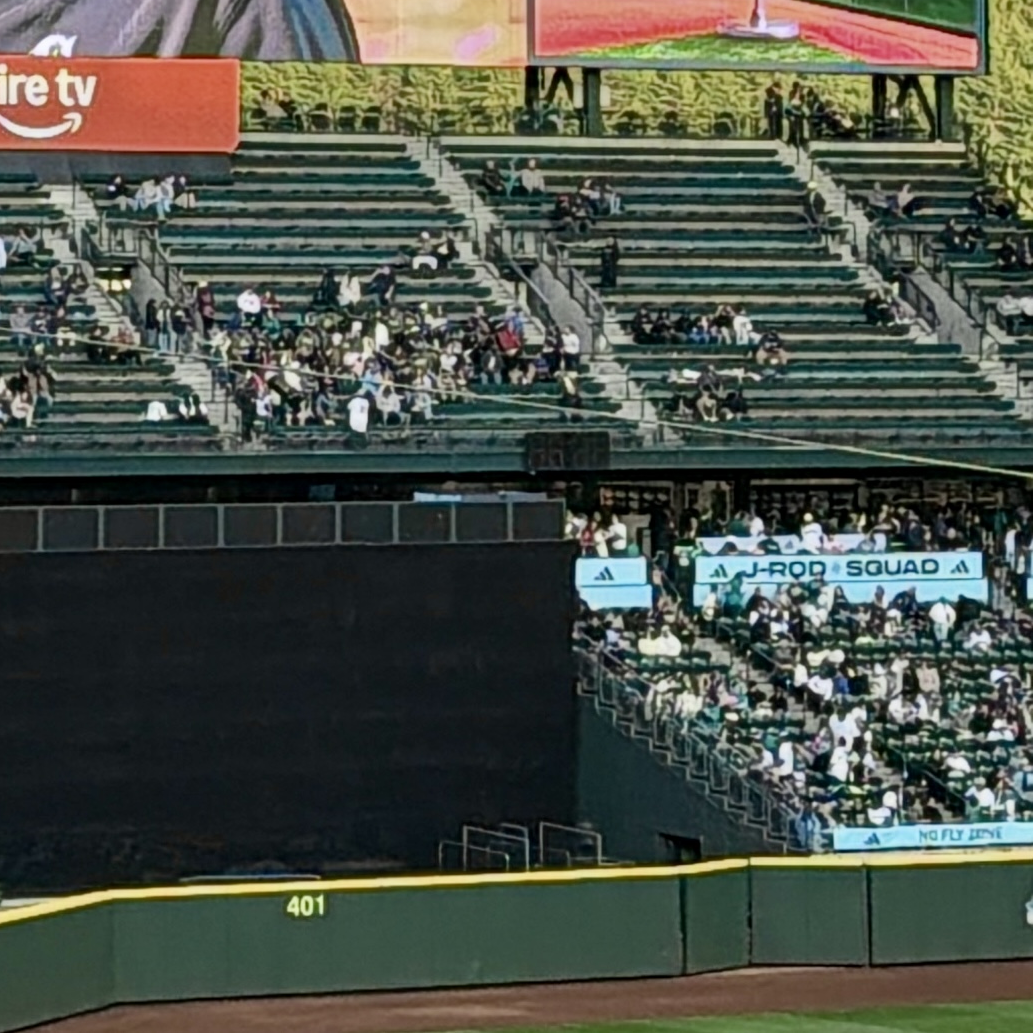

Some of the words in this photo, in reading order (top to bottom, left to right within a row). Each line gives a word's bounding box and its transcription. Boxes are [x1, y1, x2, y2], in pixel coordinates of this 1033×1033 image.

[54, 67, 97, 107] tv
[845, 558, 940, 578] SQUAD
[941, 828, 964, 841] FLY
[286, 893, 324, 917] 401
